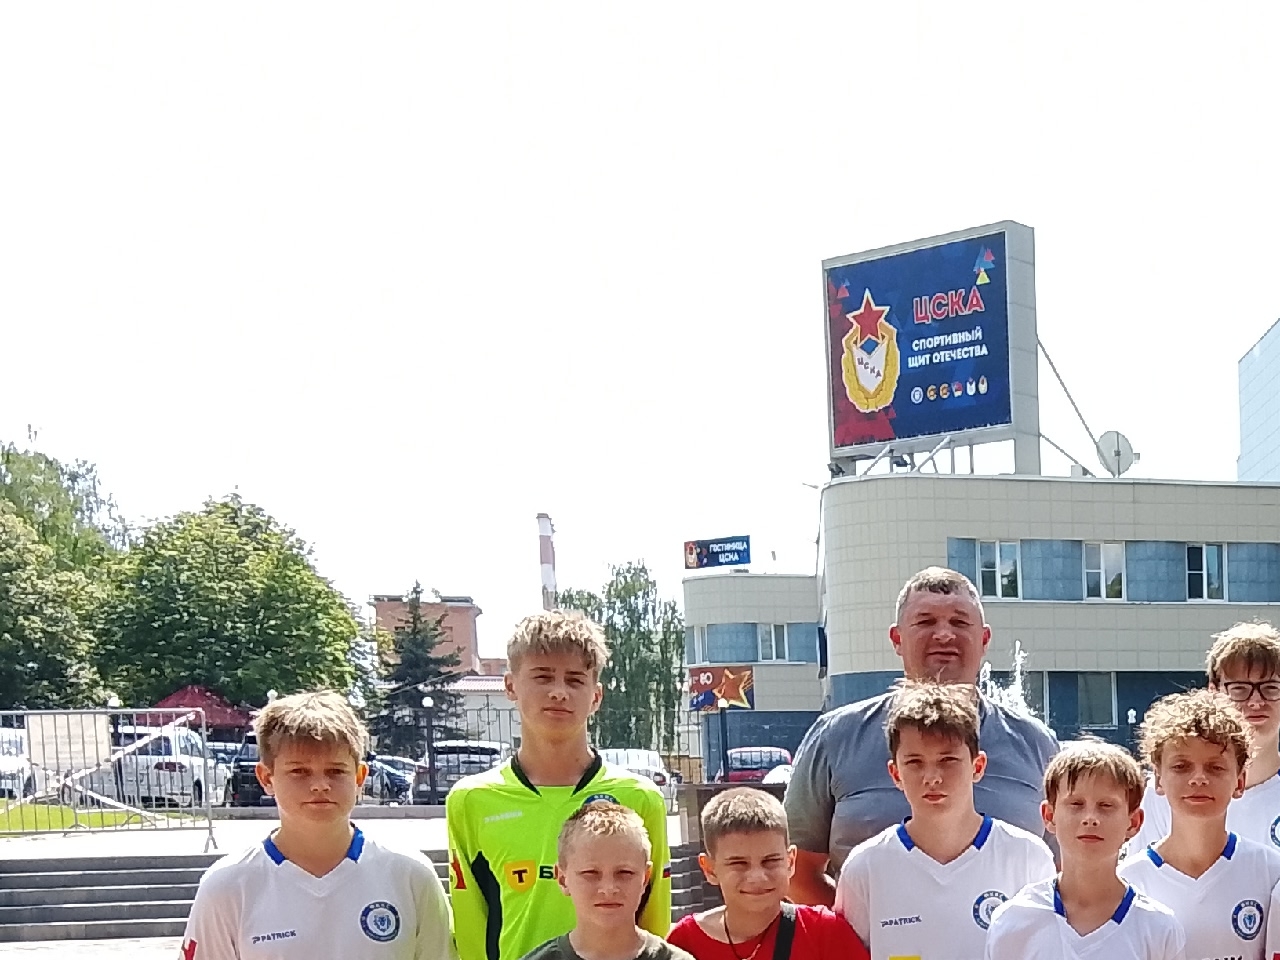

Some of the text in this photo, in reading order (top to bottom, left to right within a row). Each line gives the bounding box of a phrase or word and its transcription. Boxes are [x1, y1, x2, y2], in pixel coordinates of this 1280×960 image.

[913, 285, 985, 324] ЦСКА
[912, 326, 983, 351] СПОРТИВНЫЙ
[908, 344, 988, 368] ЩИТ ОТЕЧЕСТВА
[260, 929, 297, 943] PATRICK
